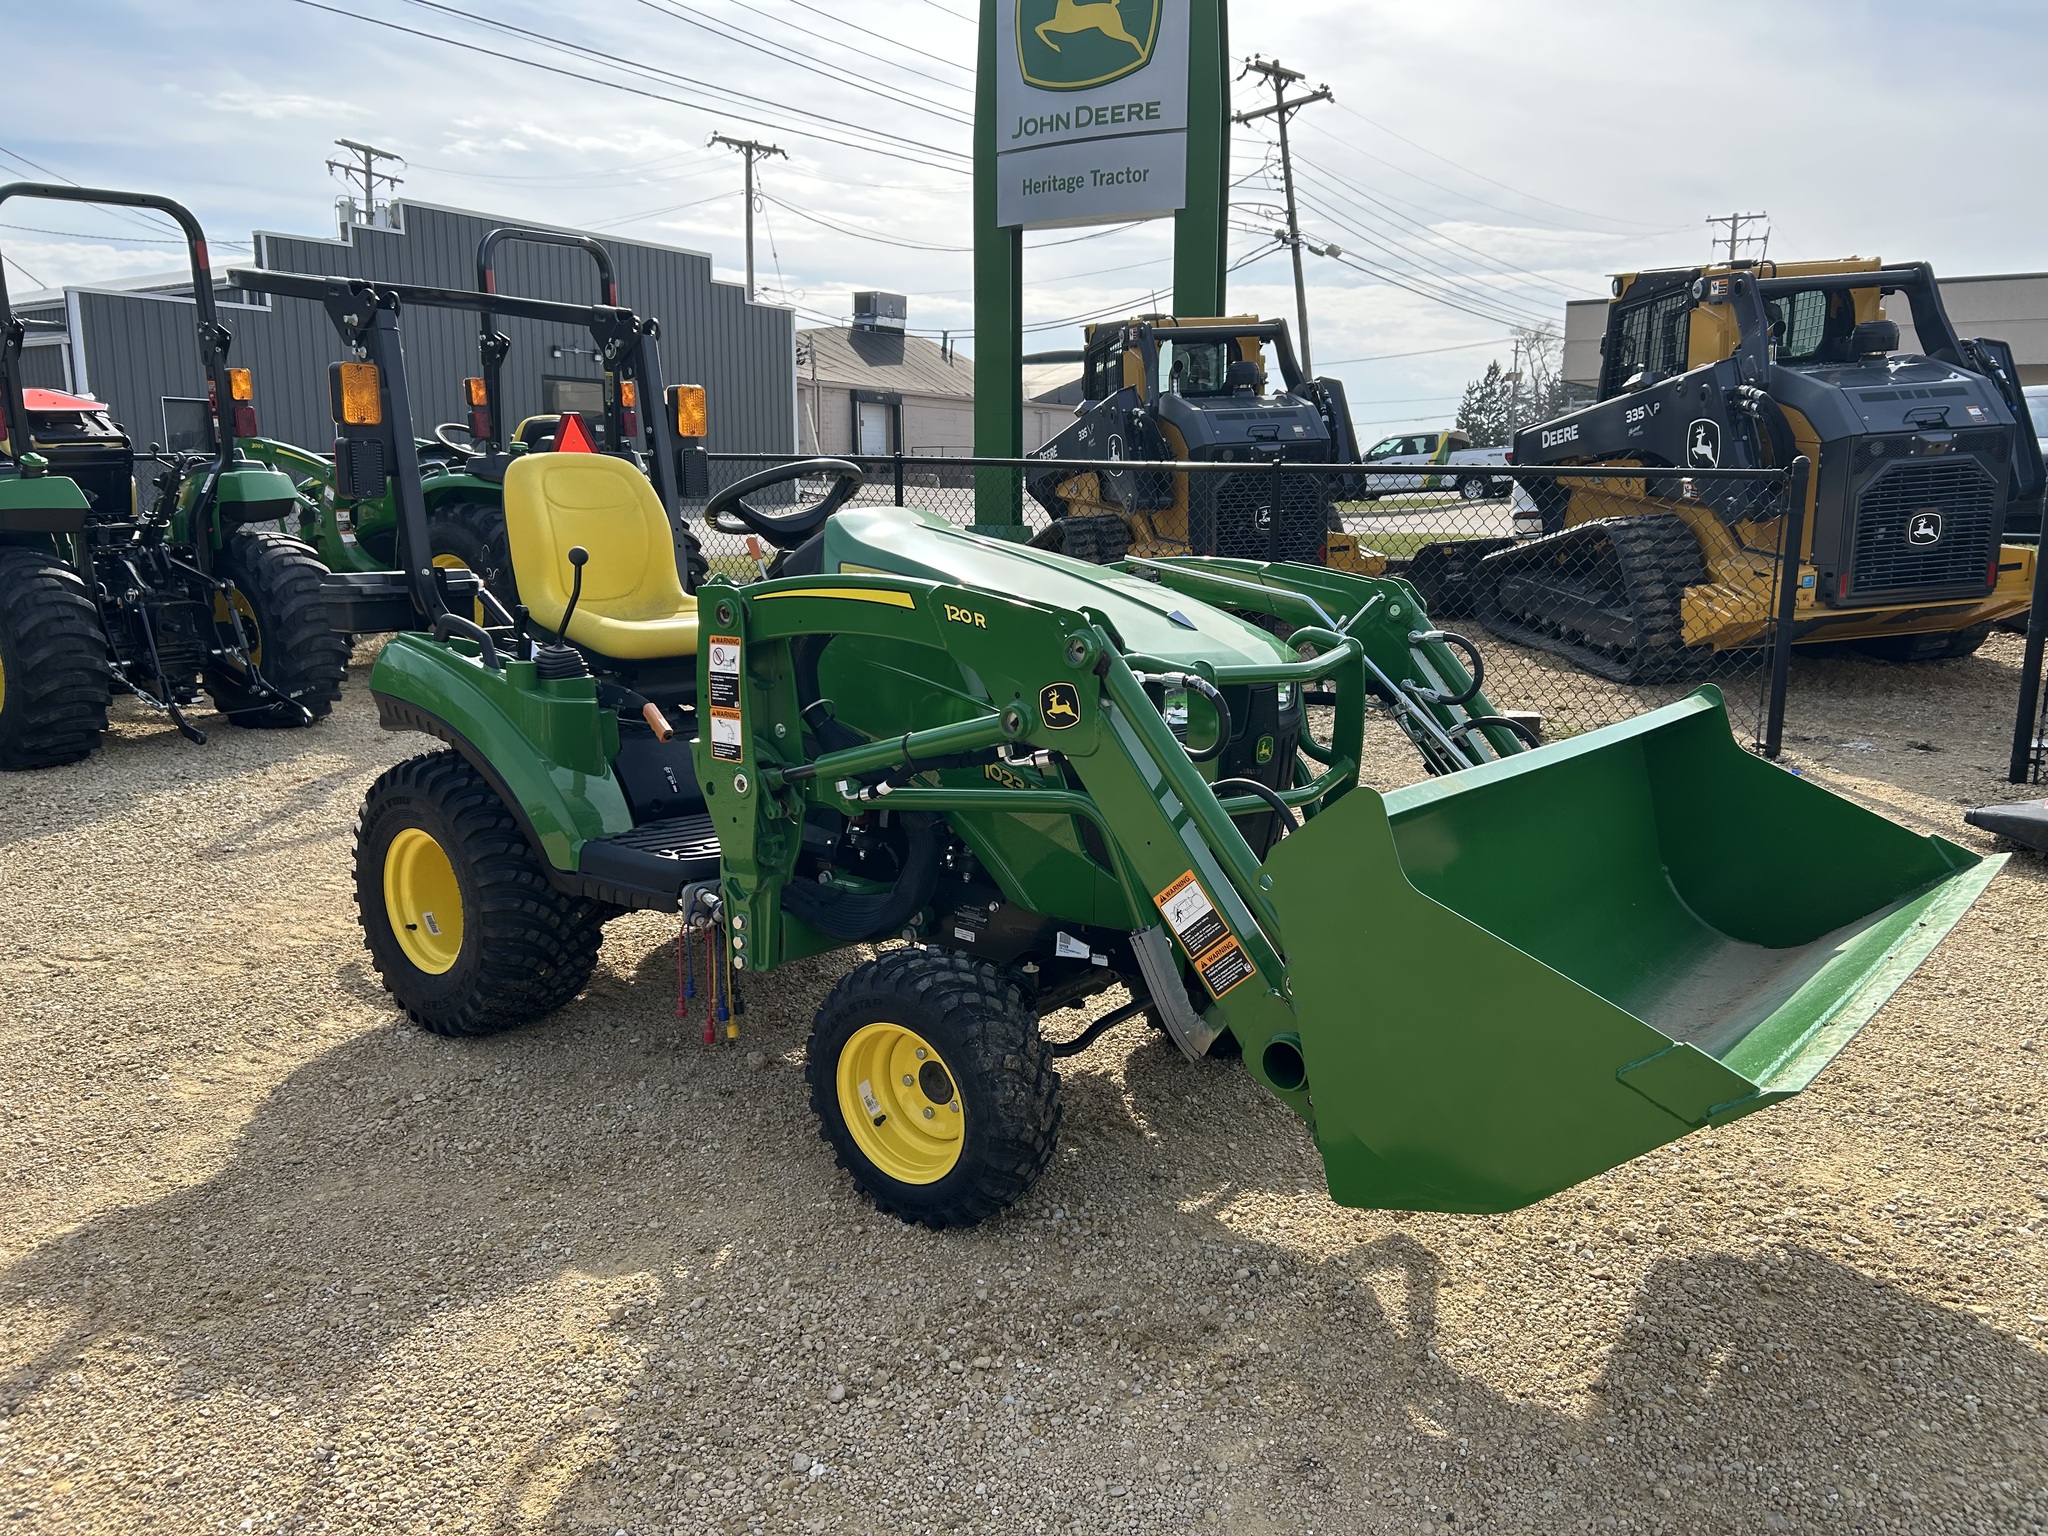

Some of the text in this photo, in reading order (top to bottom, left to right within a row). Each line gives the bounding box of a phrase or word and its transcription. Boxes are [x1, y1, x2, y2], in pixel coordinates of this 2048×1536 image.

[1011, 101, 1161, 139] JOHN DEERE
[1022, 167, 1150, 196] Heritage Tractor
[1541, 424, 1579, 449] DEERE
[1039, 444, 1058, 460] DEERE
[715, 637, 740, 645] WARNING
[716, 710, 740, 720] WARNING
[385, 796, 415, 808] TURF
[1165, 875, 1191, 898] WARNING
[1206, 941, 1234, 963] WARNING
